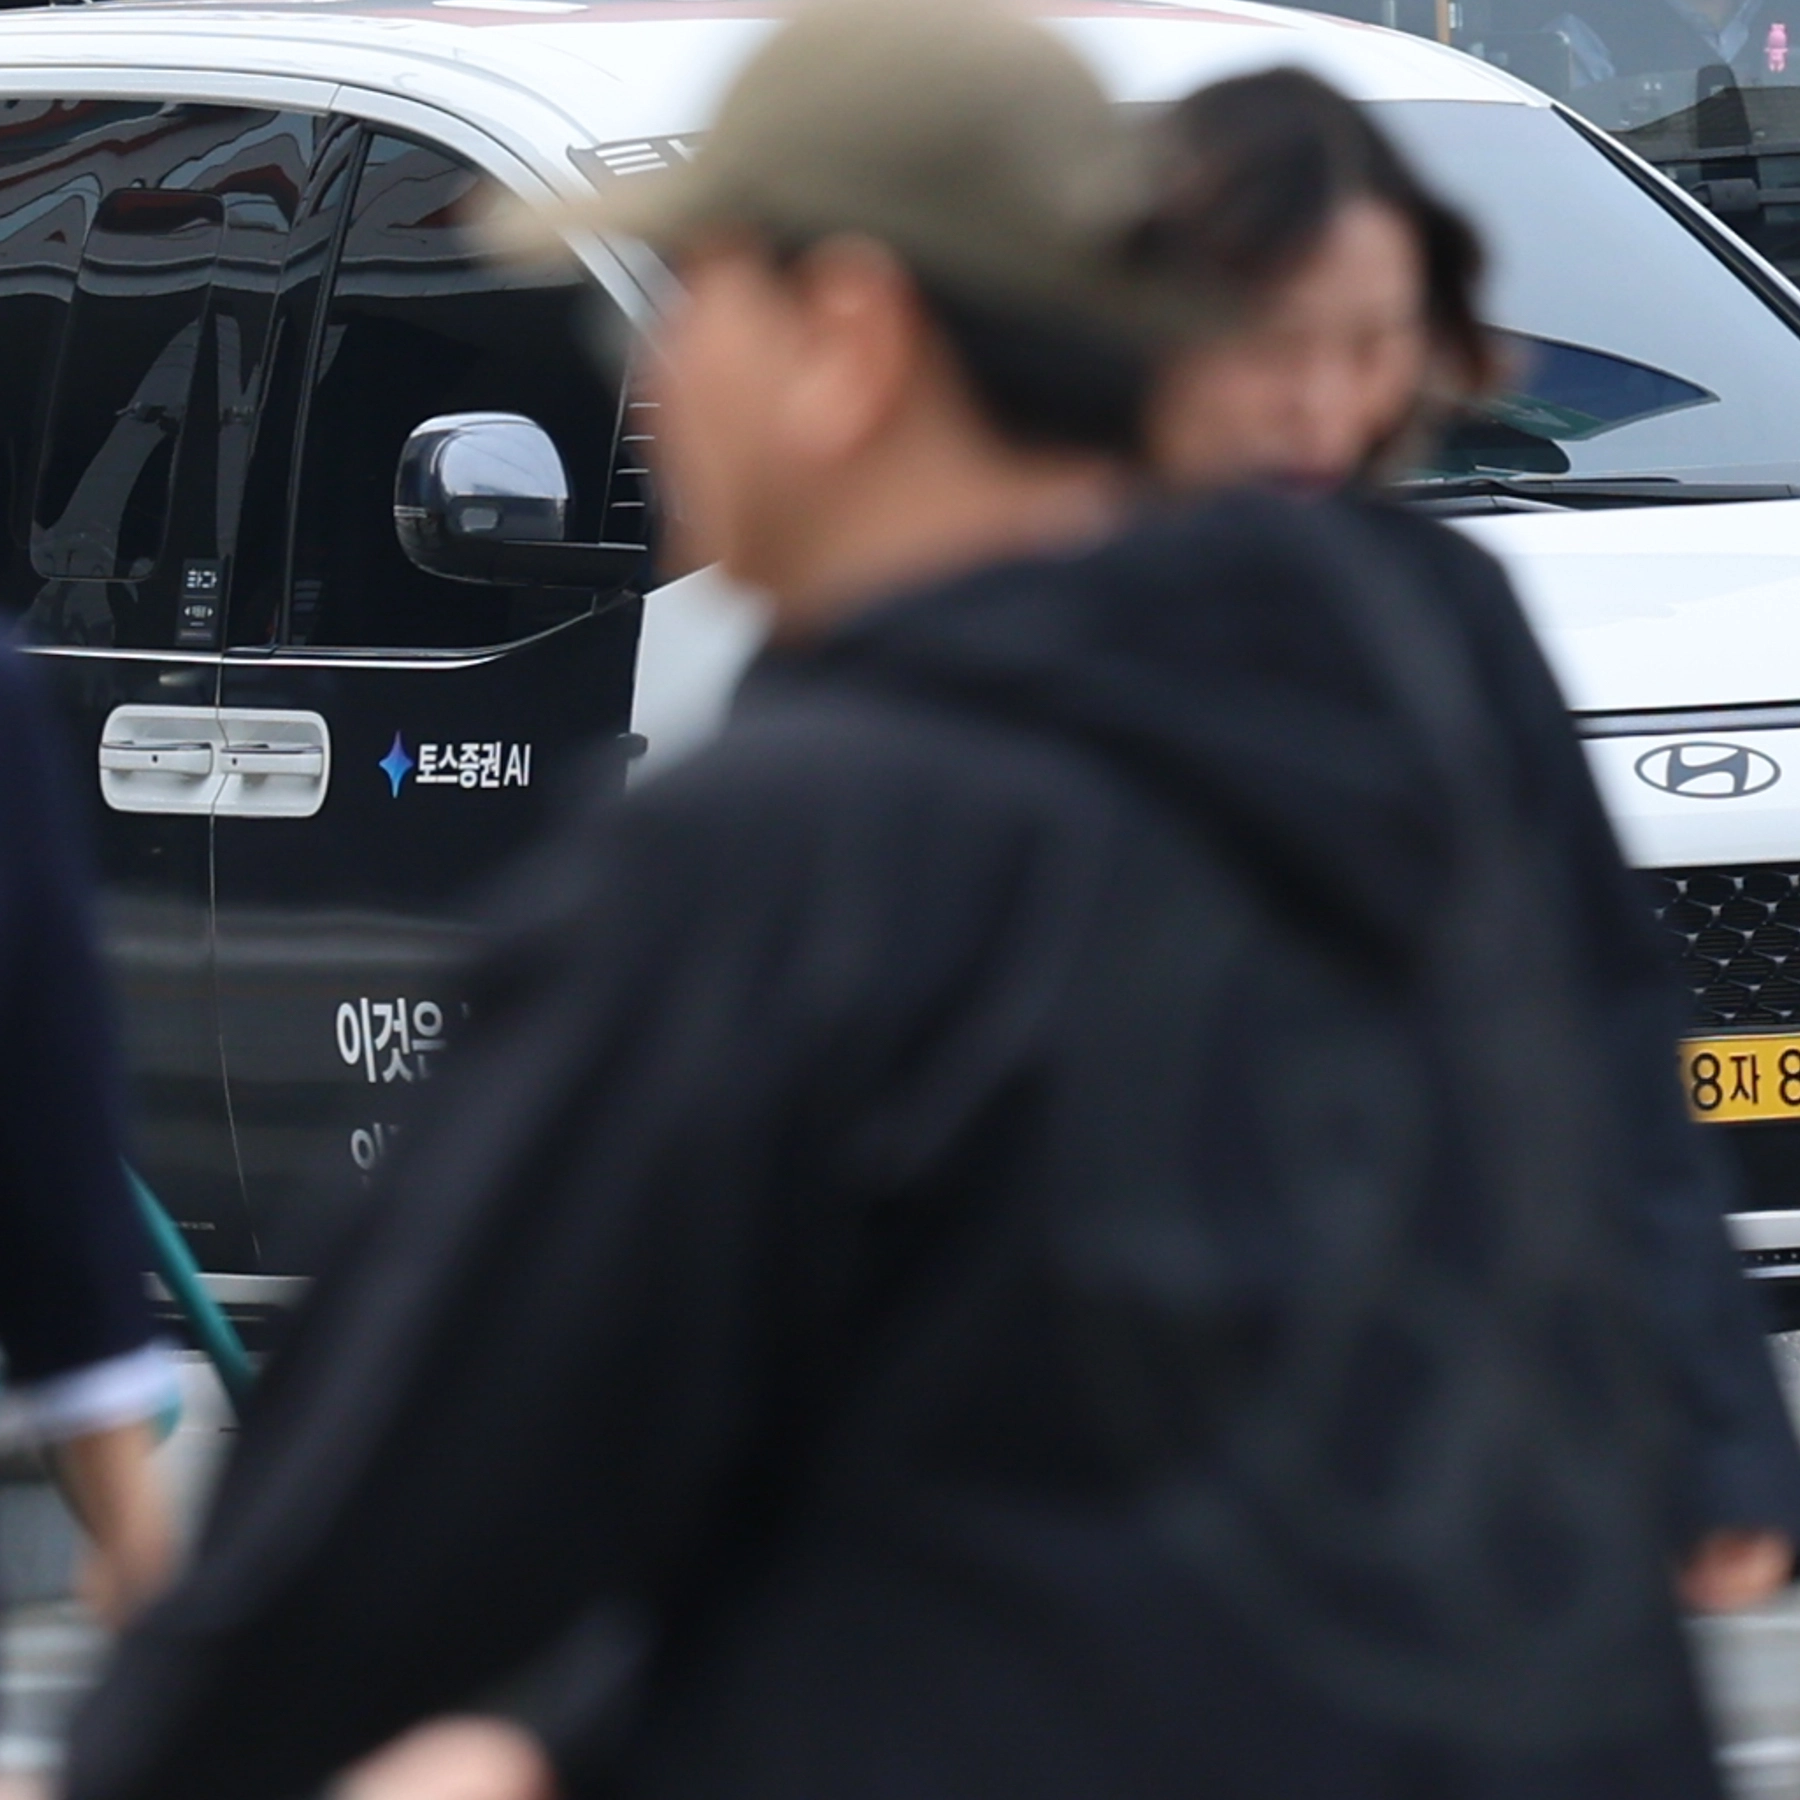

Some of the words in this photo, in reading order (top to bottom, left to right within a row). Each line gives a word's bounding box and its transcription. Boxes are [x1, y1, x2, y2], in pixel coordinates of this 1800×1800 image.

[415, 741, 501, 788] 토스증권
[503, 743, 531, 787] AI
[336, 997, 447, 1084] 이것은
[1675, 1052, 1760, 1111] 8자
